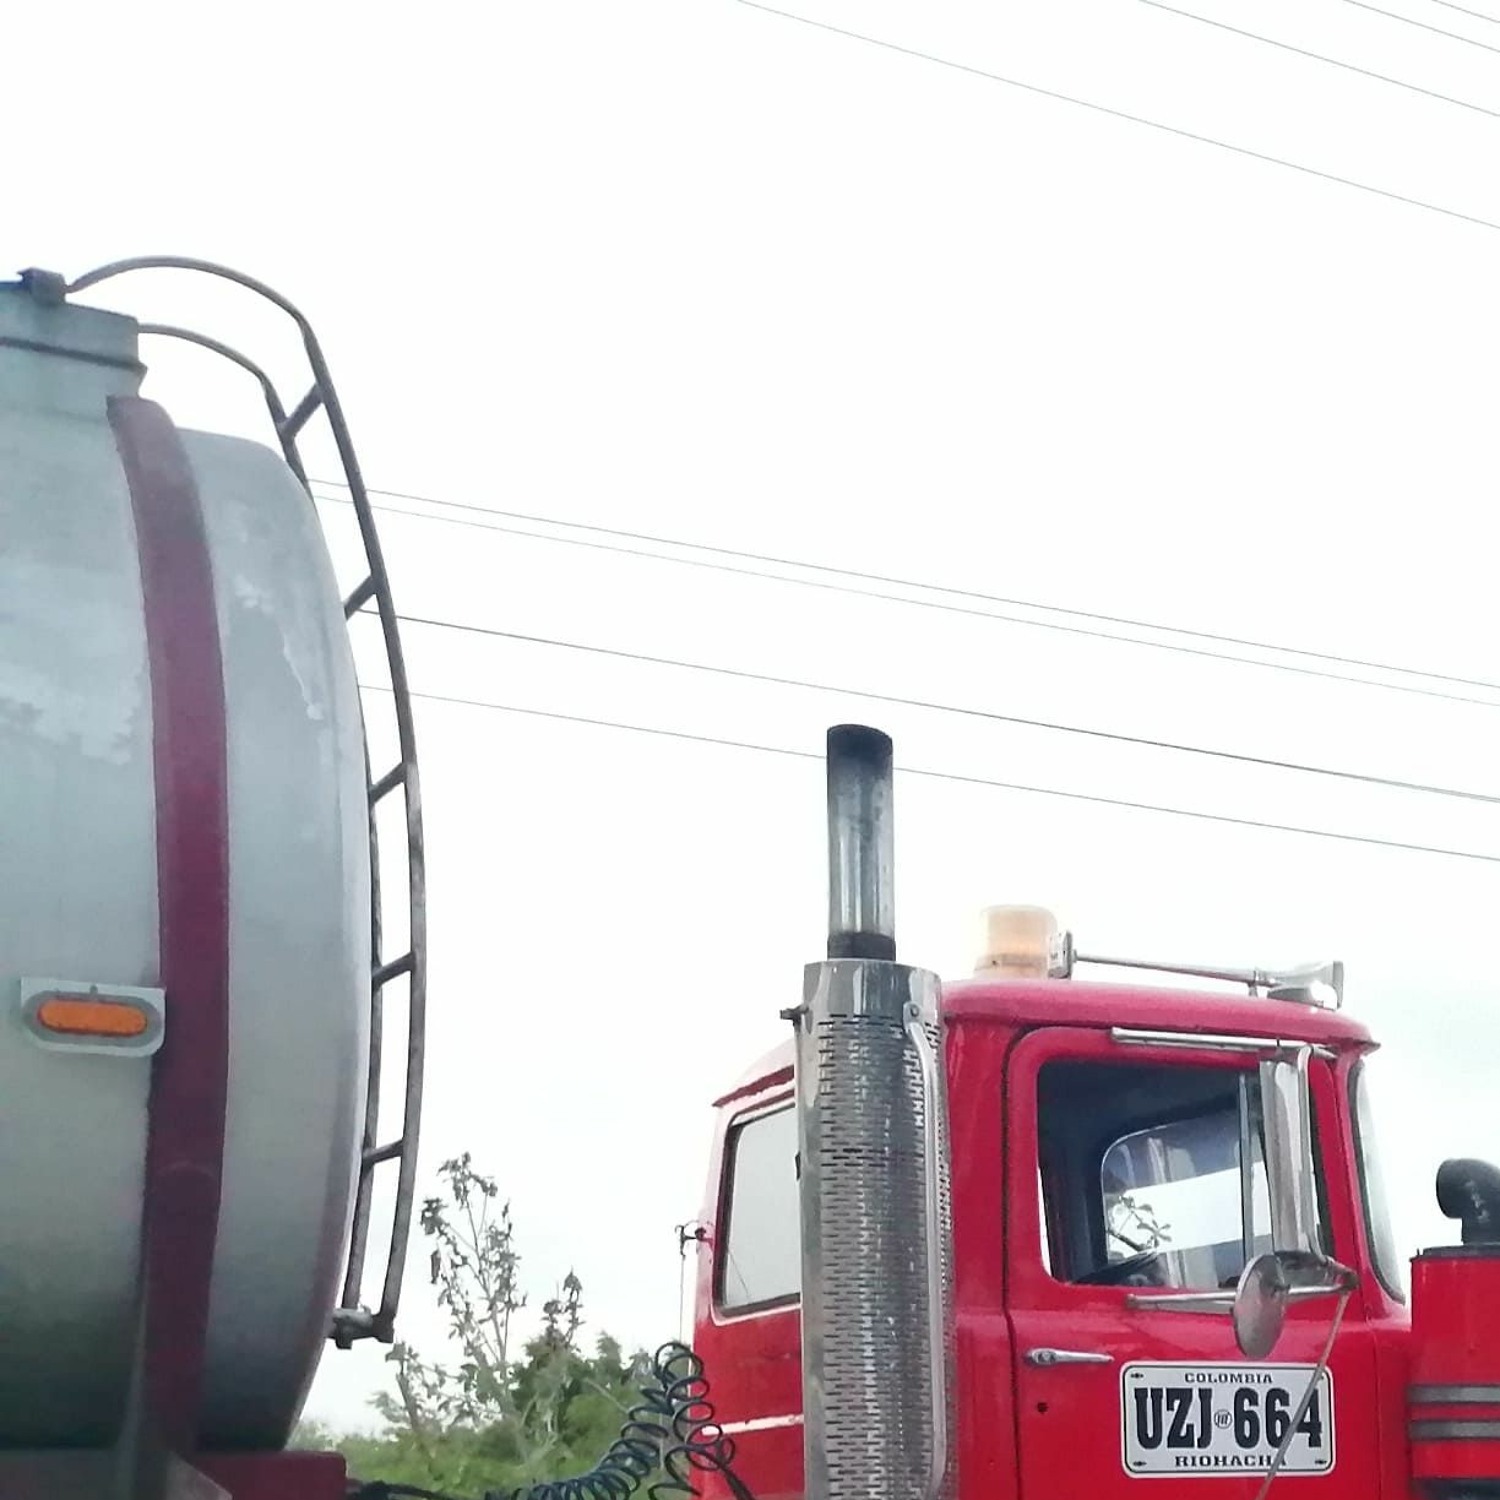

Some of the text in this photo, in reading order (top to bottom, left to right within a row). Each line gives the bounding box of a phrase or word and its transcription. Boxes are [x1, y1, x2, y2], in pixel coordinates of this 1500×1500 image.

[1184, 1372, 1273, 1384] COLOMBIA
[1133, 1386, 1323, 1450] UZJ 664
